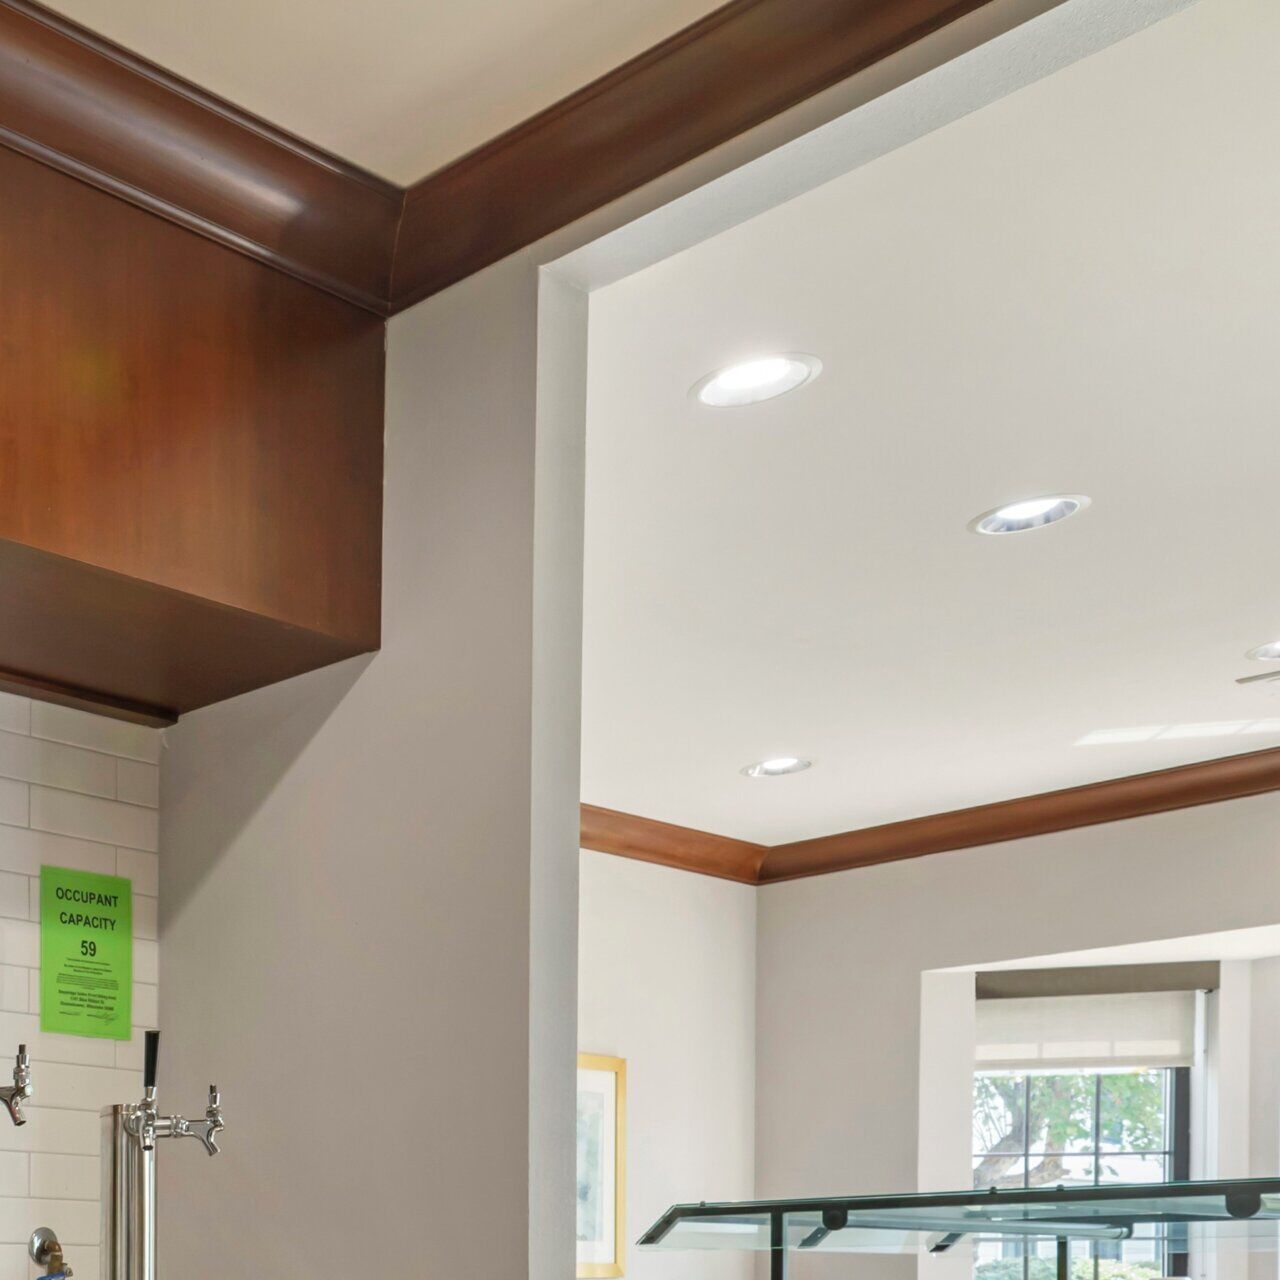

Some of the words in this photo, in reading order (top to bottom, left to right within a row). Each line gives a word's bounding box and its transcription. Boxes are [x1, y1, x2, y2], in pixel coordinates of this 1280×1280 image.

[55, 886, 119, 908] OCCUPANT
[60, 911, 117, 931] CAPACITY
[80, 939, 97, 957] 59
